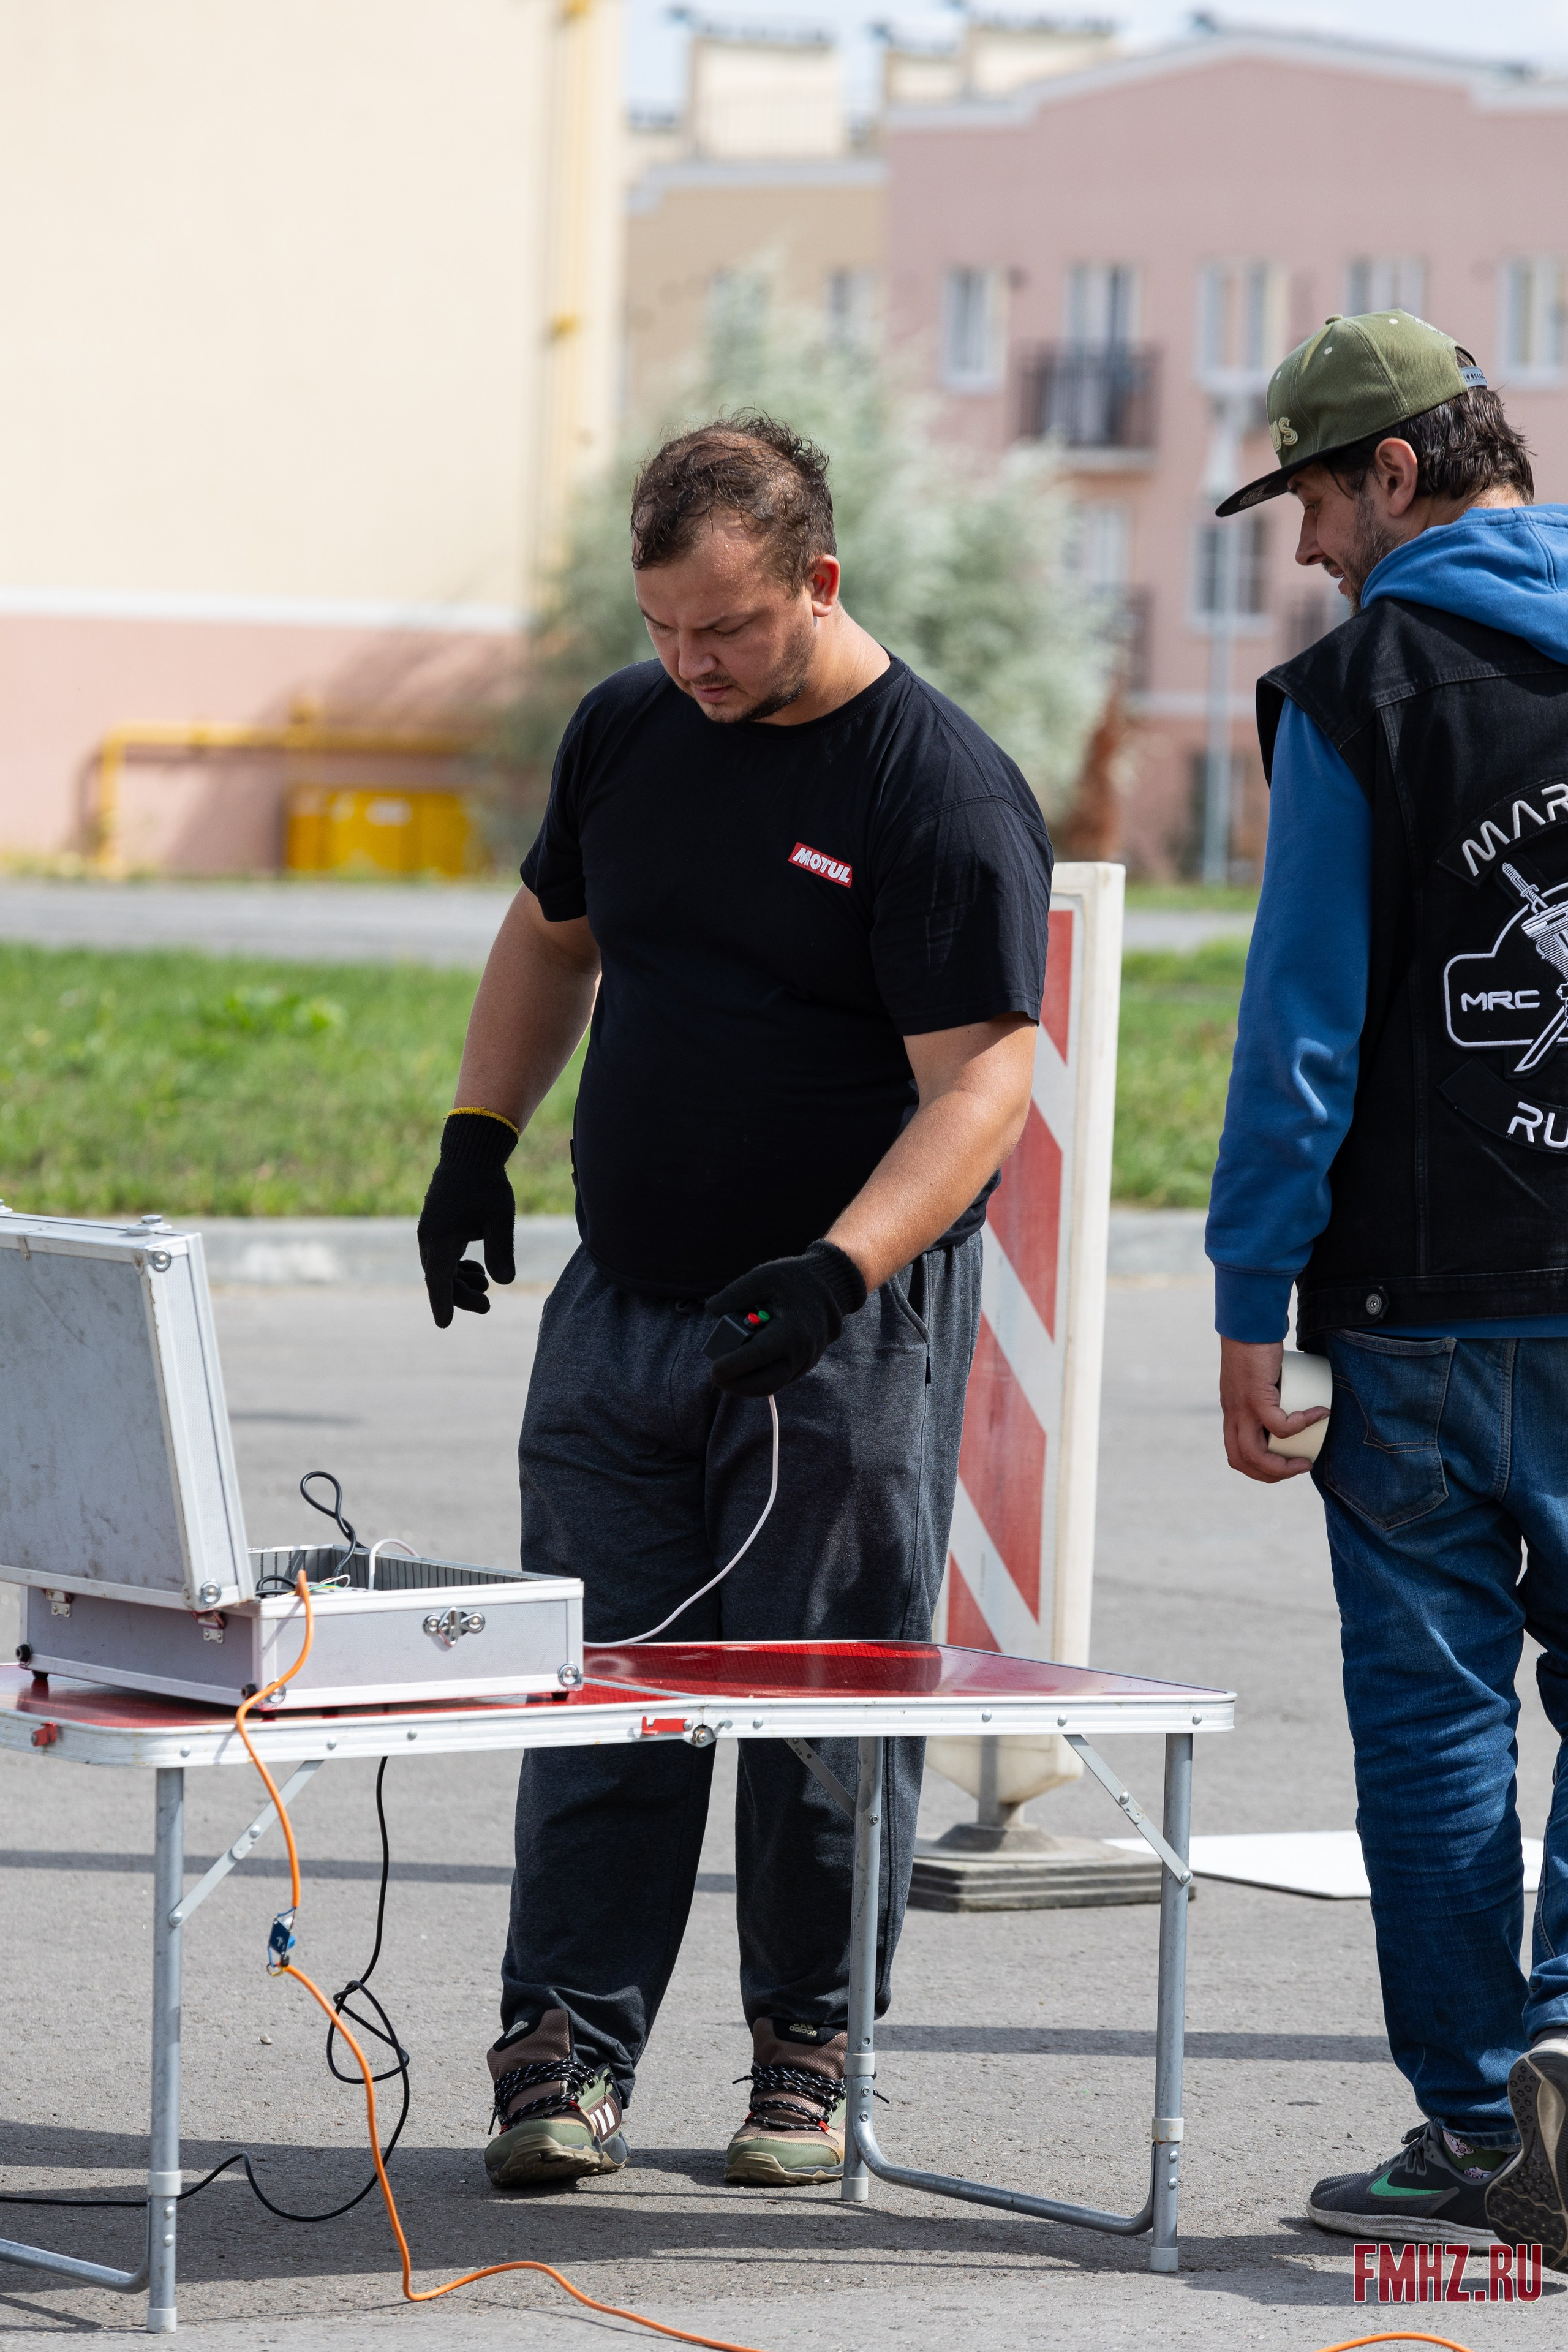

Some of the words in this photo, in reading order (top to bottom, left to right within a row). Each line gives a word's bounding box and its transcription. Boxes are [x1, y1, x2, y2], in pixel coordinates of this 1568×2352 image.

[1462, 783, 1568, 876] MAR
[792, 847, 850, 883] MOTUL
[1461, 990, 1540, 1012] MRC
[1507, 1101, 1568, 1148] RU
[789, 2026, 818, 2037] adidas
